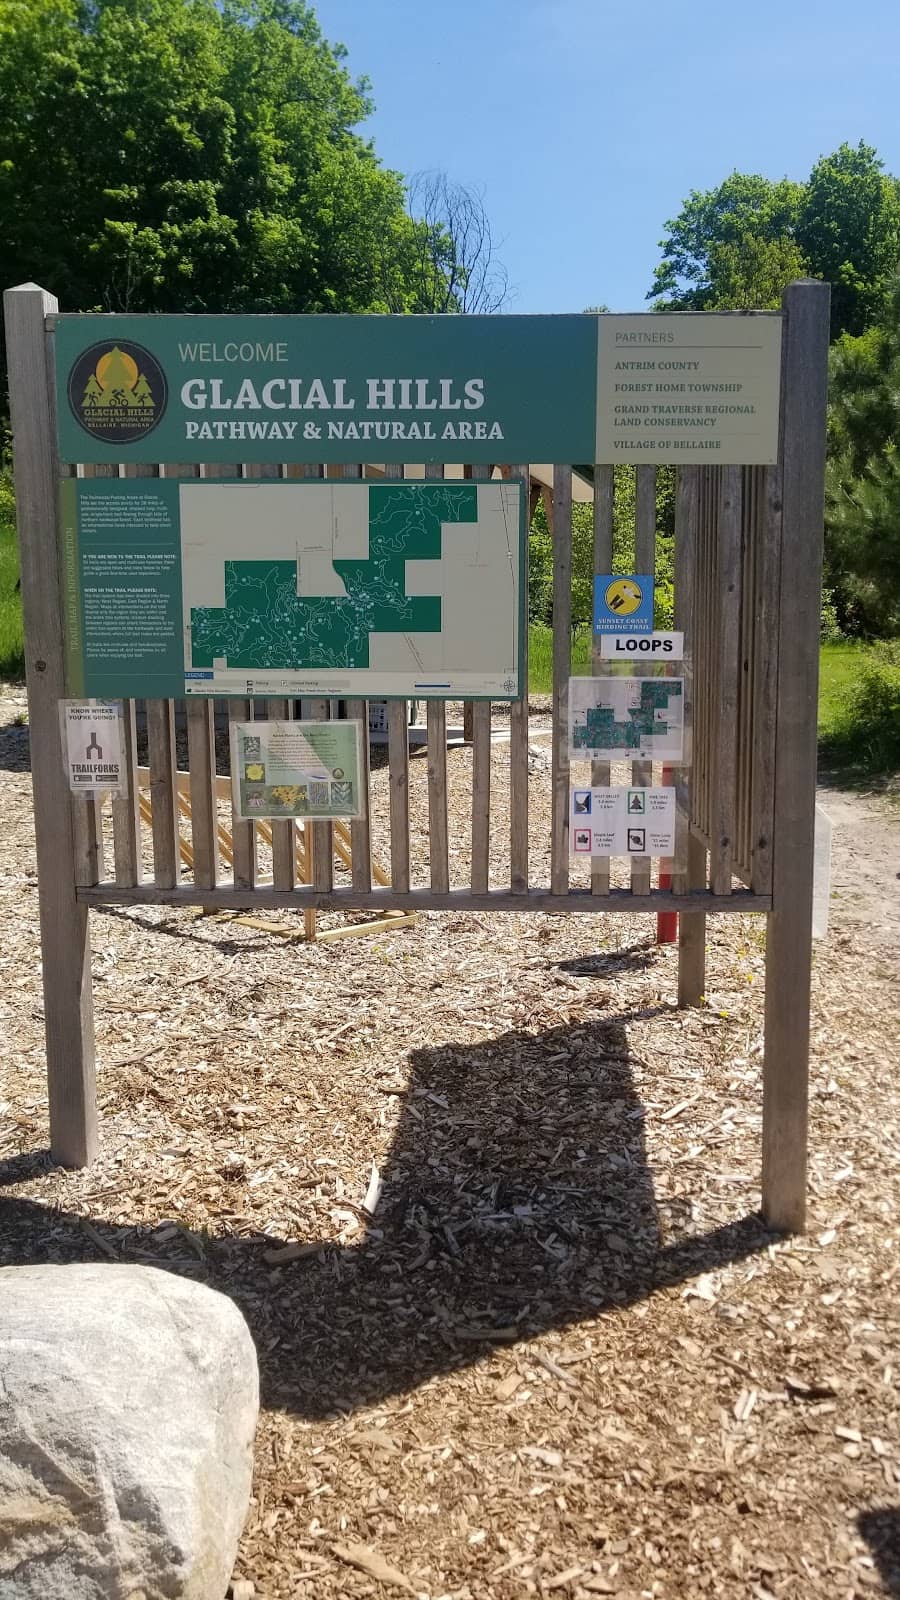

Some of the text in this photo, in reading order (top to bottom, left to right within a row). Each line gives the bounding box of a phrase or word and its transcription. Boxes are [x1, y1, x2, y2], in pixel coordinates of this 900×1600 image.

[615, 332, 674, 343] PARTNERS
[178, 343, 289, 362] WELCOME
[614, 361, 700, 370] ANTRIM COUNTY
[614, 383, 743, 392] FOREST HOME TOWNSHIP
[180, 378, 485, 410] GLACIAL HILLS
[84, 408, 154, 416] GLACIAL HILLS
[614, 405, 756, 414] GRAND TRAVERSE REGIONAL
[614, 418, 717, 426] LAND CONSERVANCY
[185, 421, 505, 440] PATHWAY & NATURAL AREA
[614, 440, 721, 449] VILLAGE OF BELLAIRE
[615, 639, 673, 652] LOOPS
[71, 764, 119, 773] TRAILFORKS
